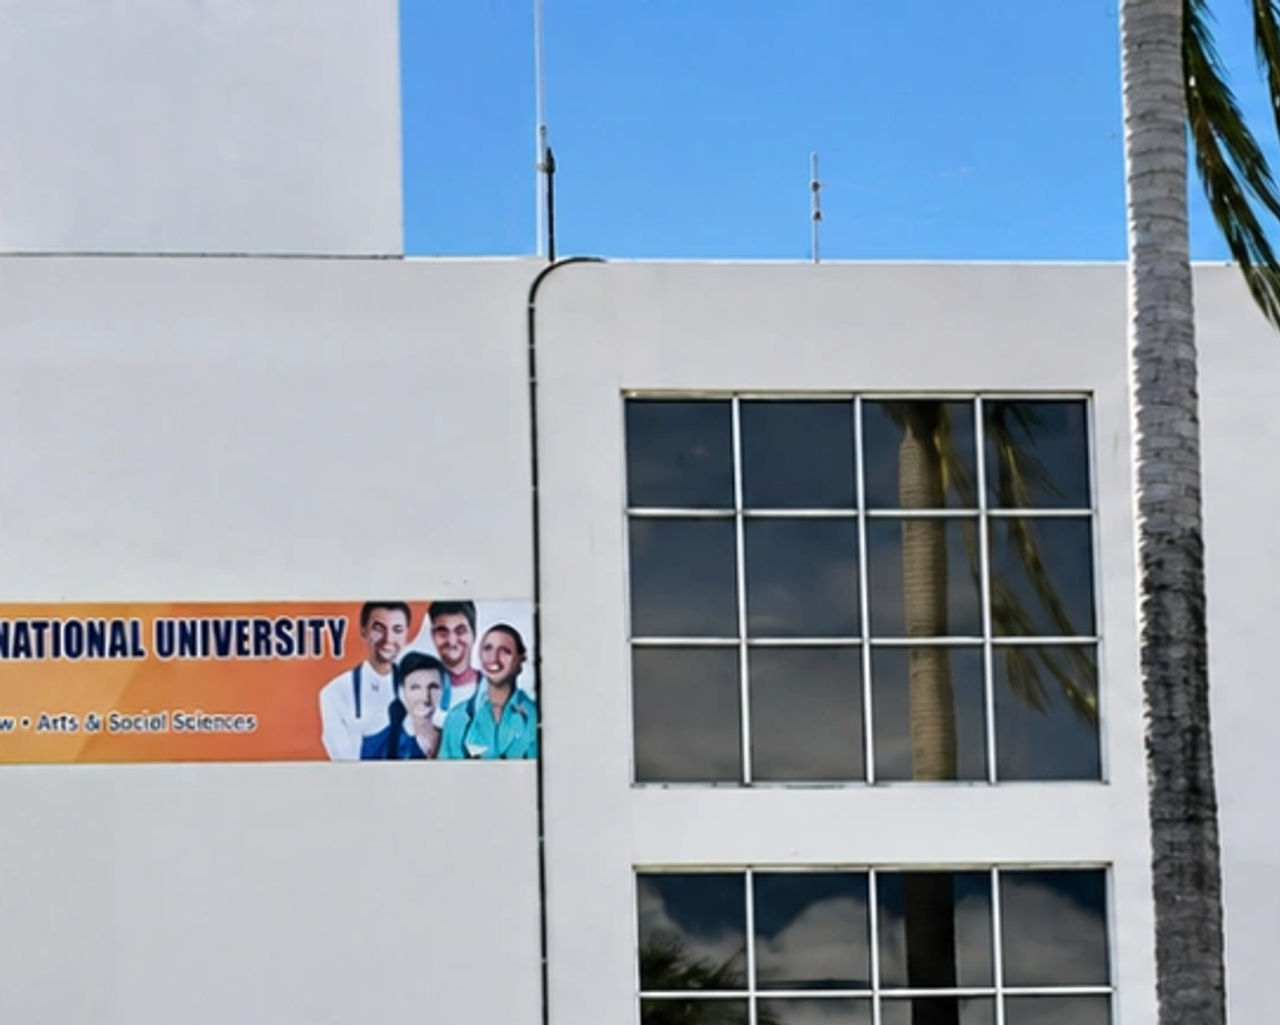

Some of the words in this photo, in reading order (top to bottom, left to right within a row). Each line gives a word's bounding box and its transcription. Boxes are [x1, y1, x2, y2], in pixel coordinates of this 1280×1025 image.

[156, 618, 347, 659] UNIVERSITY
[36, 714, 78, 732] Arts
[85, 714, 102, 732] &
[108, 713, 167, 732] Social
[174, 712, 256, 732] Sciences
